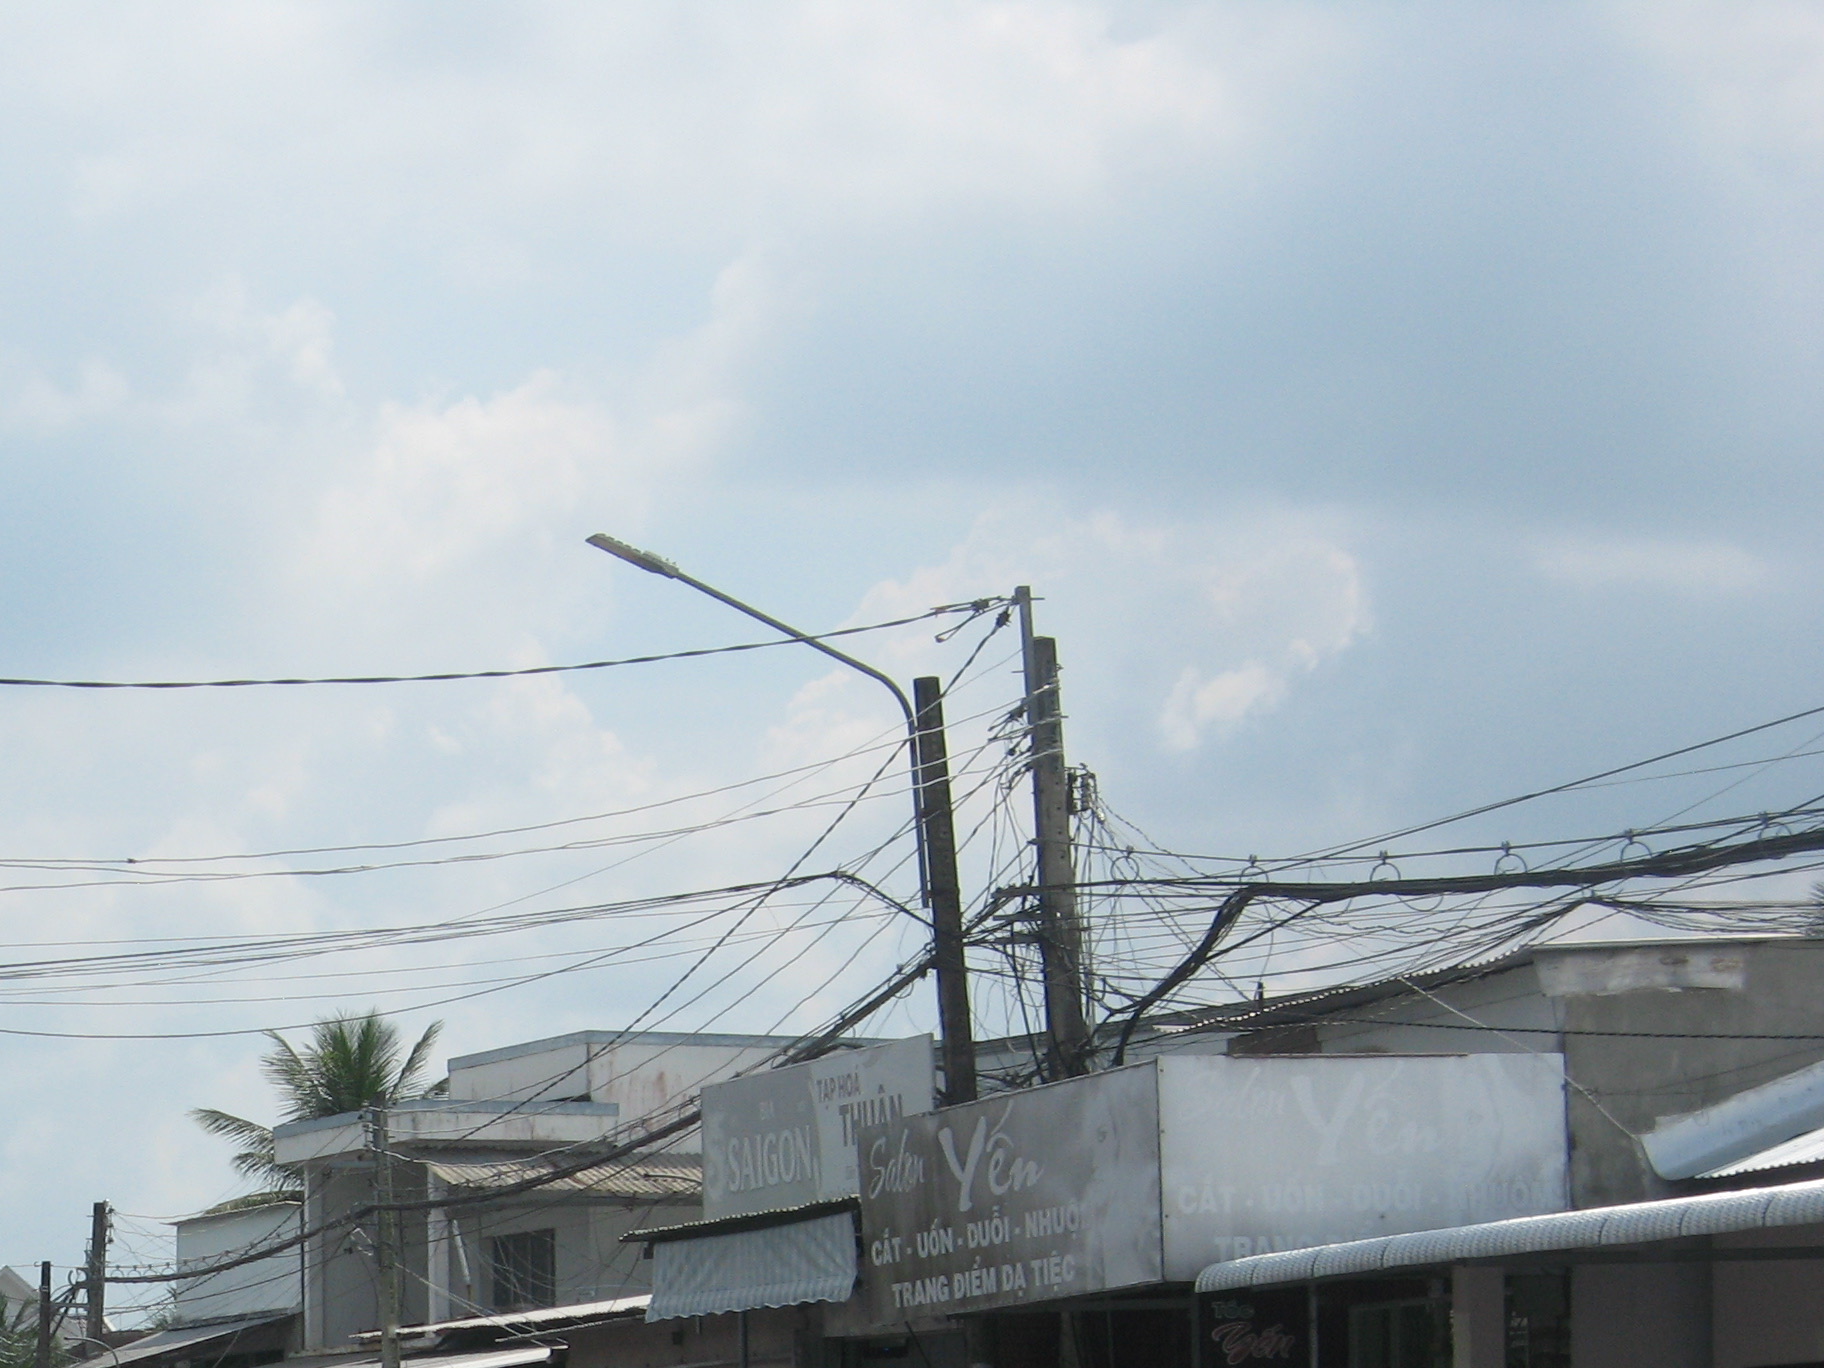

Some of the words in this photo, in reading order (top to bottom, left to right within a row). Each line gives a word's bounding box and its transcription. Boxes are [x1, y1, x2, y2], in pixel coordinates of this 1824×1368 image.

[727, 1124, 812, 1192] SAIGON
[938, 1099, 1045, 1212] Yến
[916, 1218, 953, 1258] UỐN
[892, 1275, 950, 1308] TRANG
[1031, 1250, 1076, 1292] TIỆC
